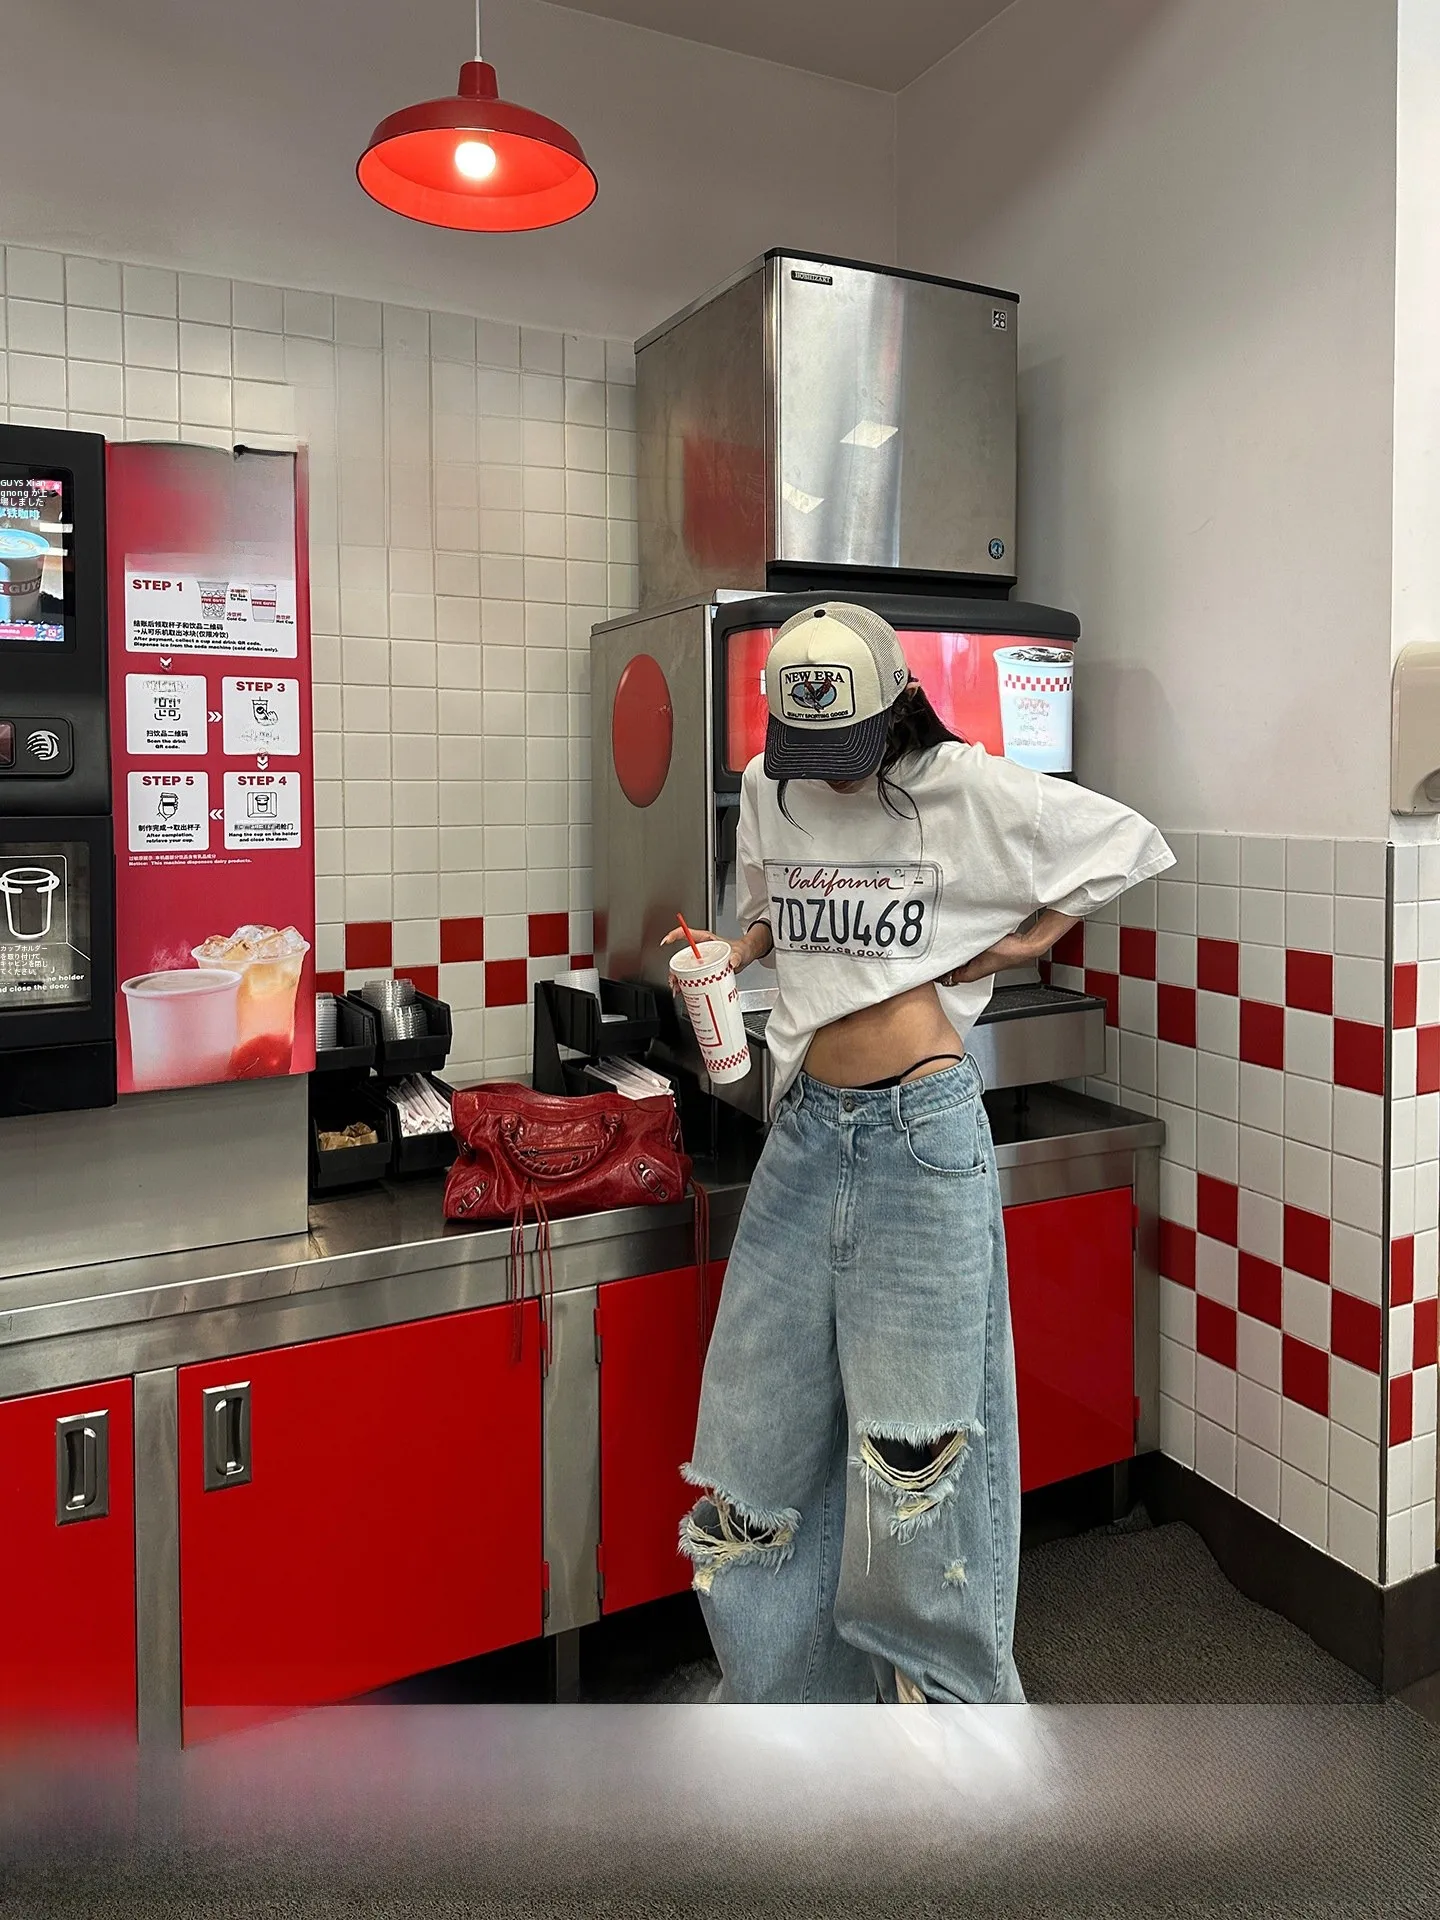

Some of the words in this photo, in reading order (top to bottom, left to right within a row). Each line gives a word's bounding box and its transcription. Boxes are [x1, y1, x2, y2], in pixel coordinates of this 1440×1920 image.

[132, 579, 172, 590] STEP
[177, 582, 183, 591] 1
[785, 671, 811, 684] NEW
[814, 671, 845, 683] ERA
[236, 681, 273, 692] STEP
[277, 683, 286, 692] 3
[142, 776, 182, 786] STEP
[185, 776, 195, 786] 5
[237, 776, 275, 786] STEP
[278, 776, 287, 786] 4
[788, 867, 904, 897] California
[772, 896, 925, 948] 7DZU468
[800, 943, 885, 958] dmv.ca.gov
